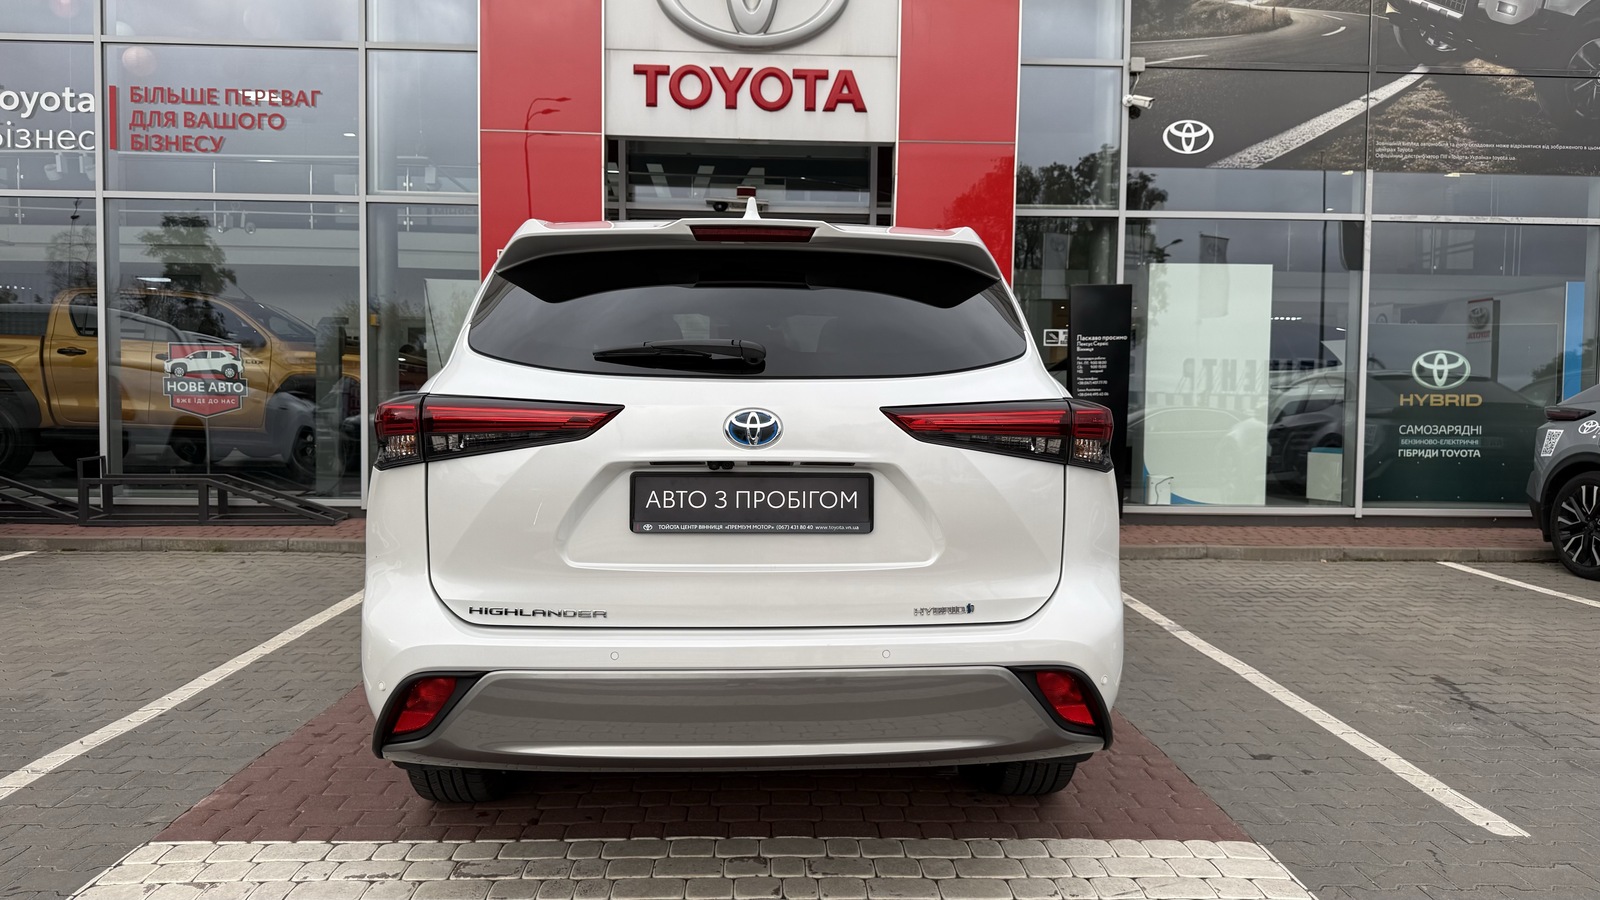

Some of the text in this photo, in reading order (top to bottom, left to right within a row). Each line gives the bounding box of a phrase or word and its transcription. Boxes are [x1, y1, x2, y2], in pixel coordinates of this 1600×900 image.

[129, 86, 322, 107] БІЛЬШЕ ПЕРЕВАГ
[633, 64, 868, 113] TOYOTA
[0, 87, 95, 118] oyota
[129, 110, 287, 131] ДЛЯ ВАШОГО
[0, 121, 95, 151] ізнес
[130, 134, 226, 153] БІЗНЕСУ
[167, 381, 244, 393] НОВЕ АВТО
[1400, 394, 1483, 407] HYBRID
[1398, 425, 1482, 436] САМОЗАРЯДНІ
[1398, 449, 1439, 458] ГІБРИДИ
[646, 490, 858, 509] АВТО З ПРОБІГОМ
[468, 607, 607, 618] HIGHLANDER
